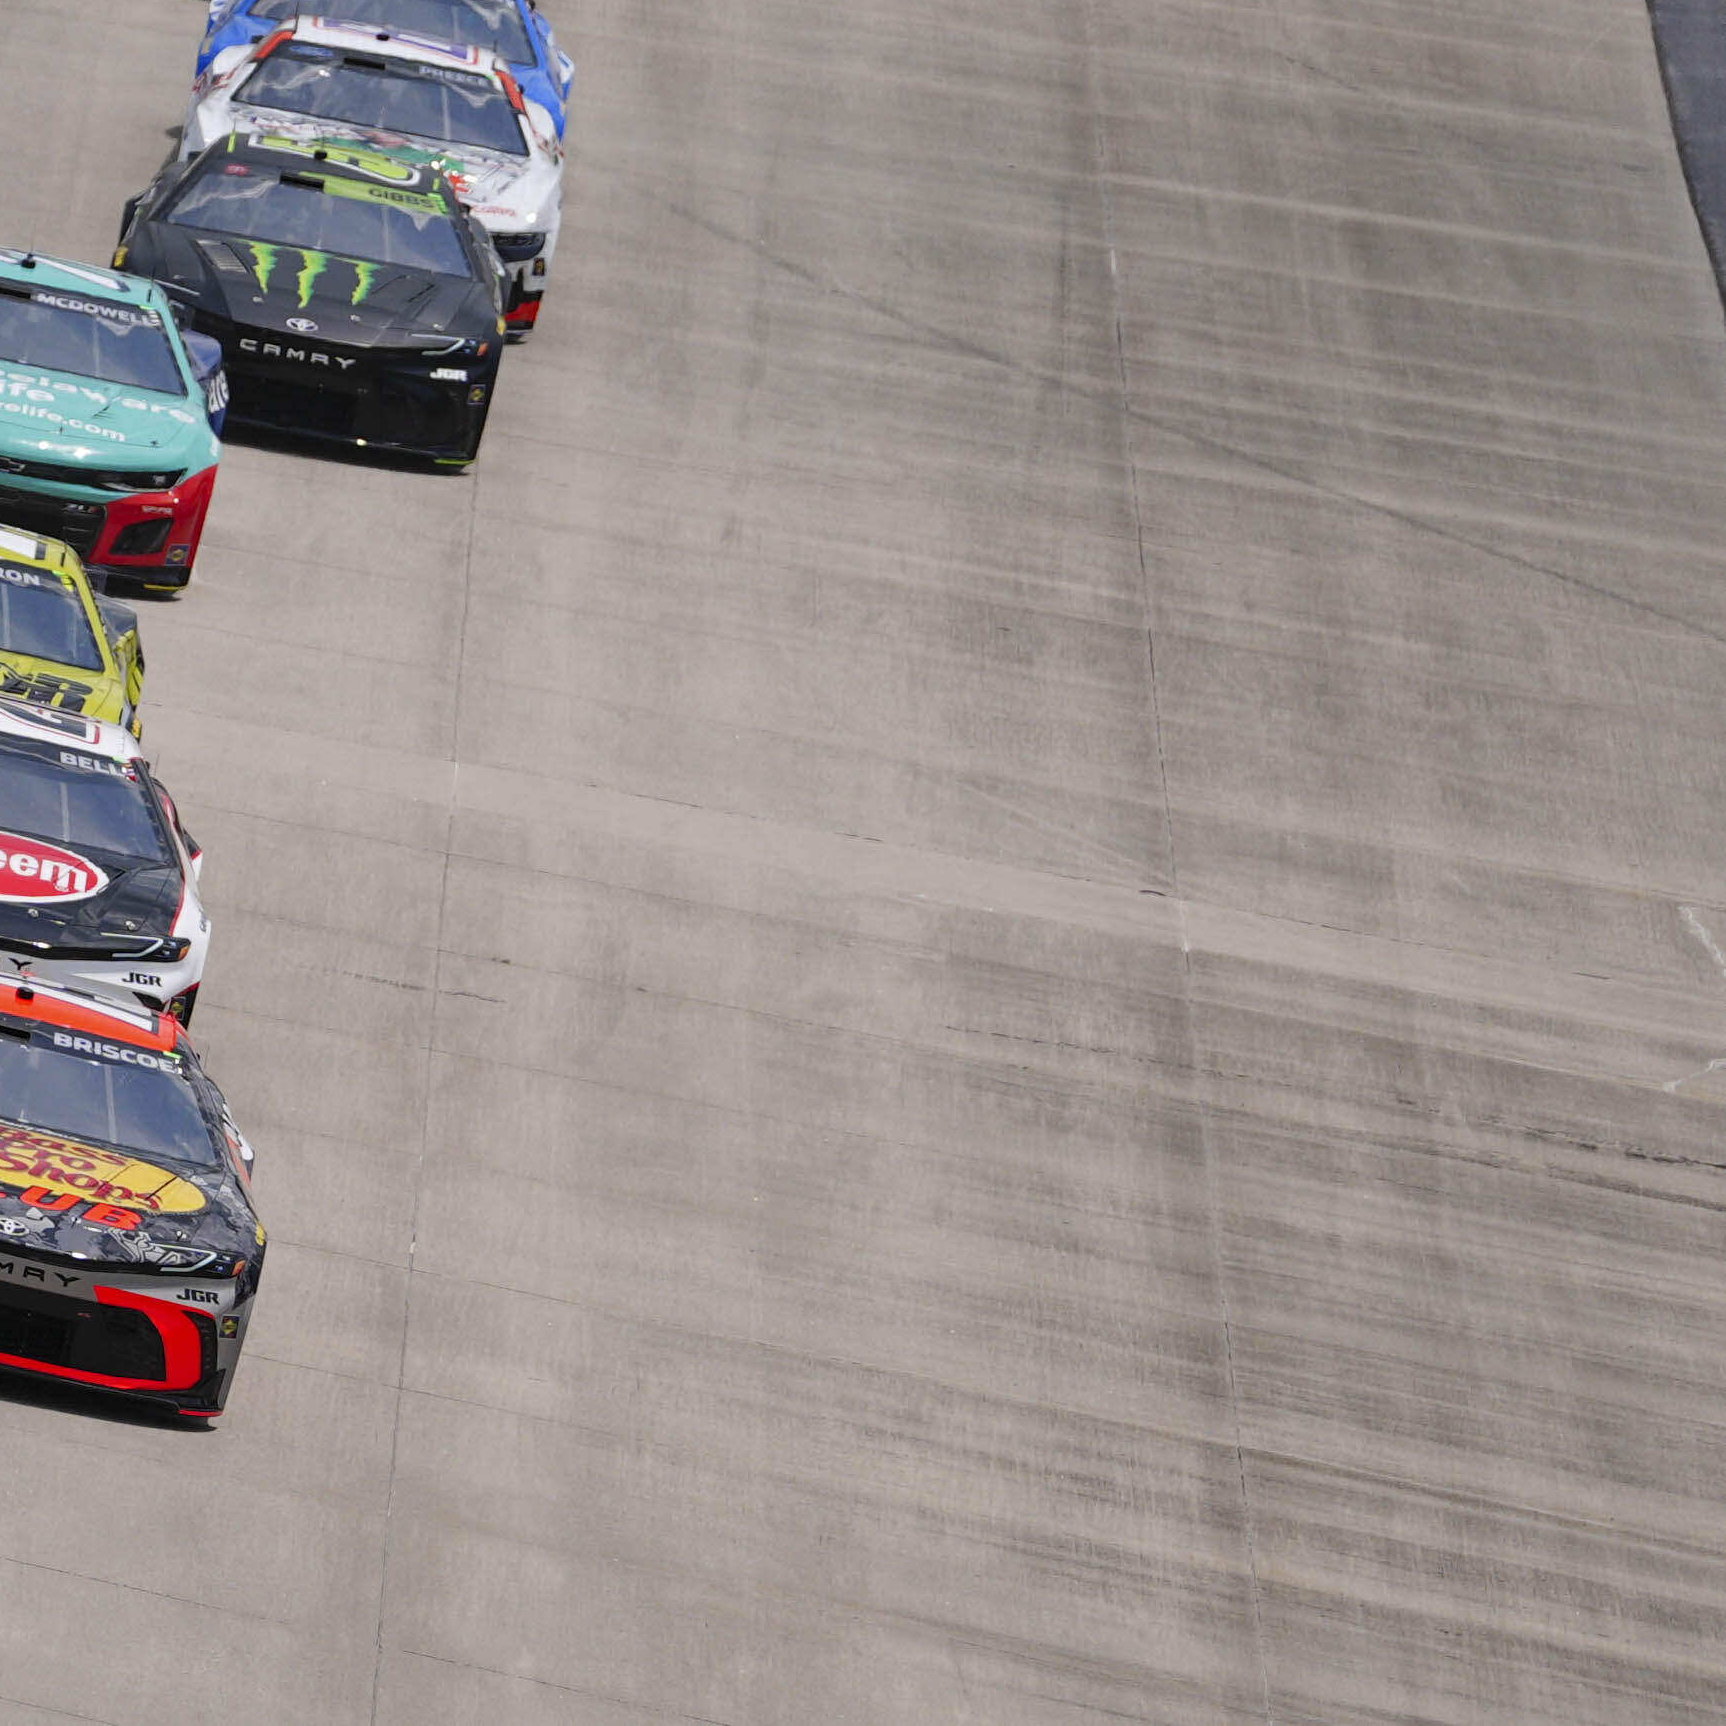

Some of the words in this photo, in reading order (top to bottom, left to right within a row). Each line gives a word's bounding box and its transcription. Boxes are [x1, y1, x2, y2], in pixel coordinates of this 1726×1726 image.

[367, 186, 435, 210] GIBBS
[239, 338, 357, 371] CAMRY
[429, 366, 468, 383] JGR
[121, 972, 164, 988] JGR
[53, 1031, 178, 1073] BRISCOE
[175, 1287, 221, 1306] JGR
